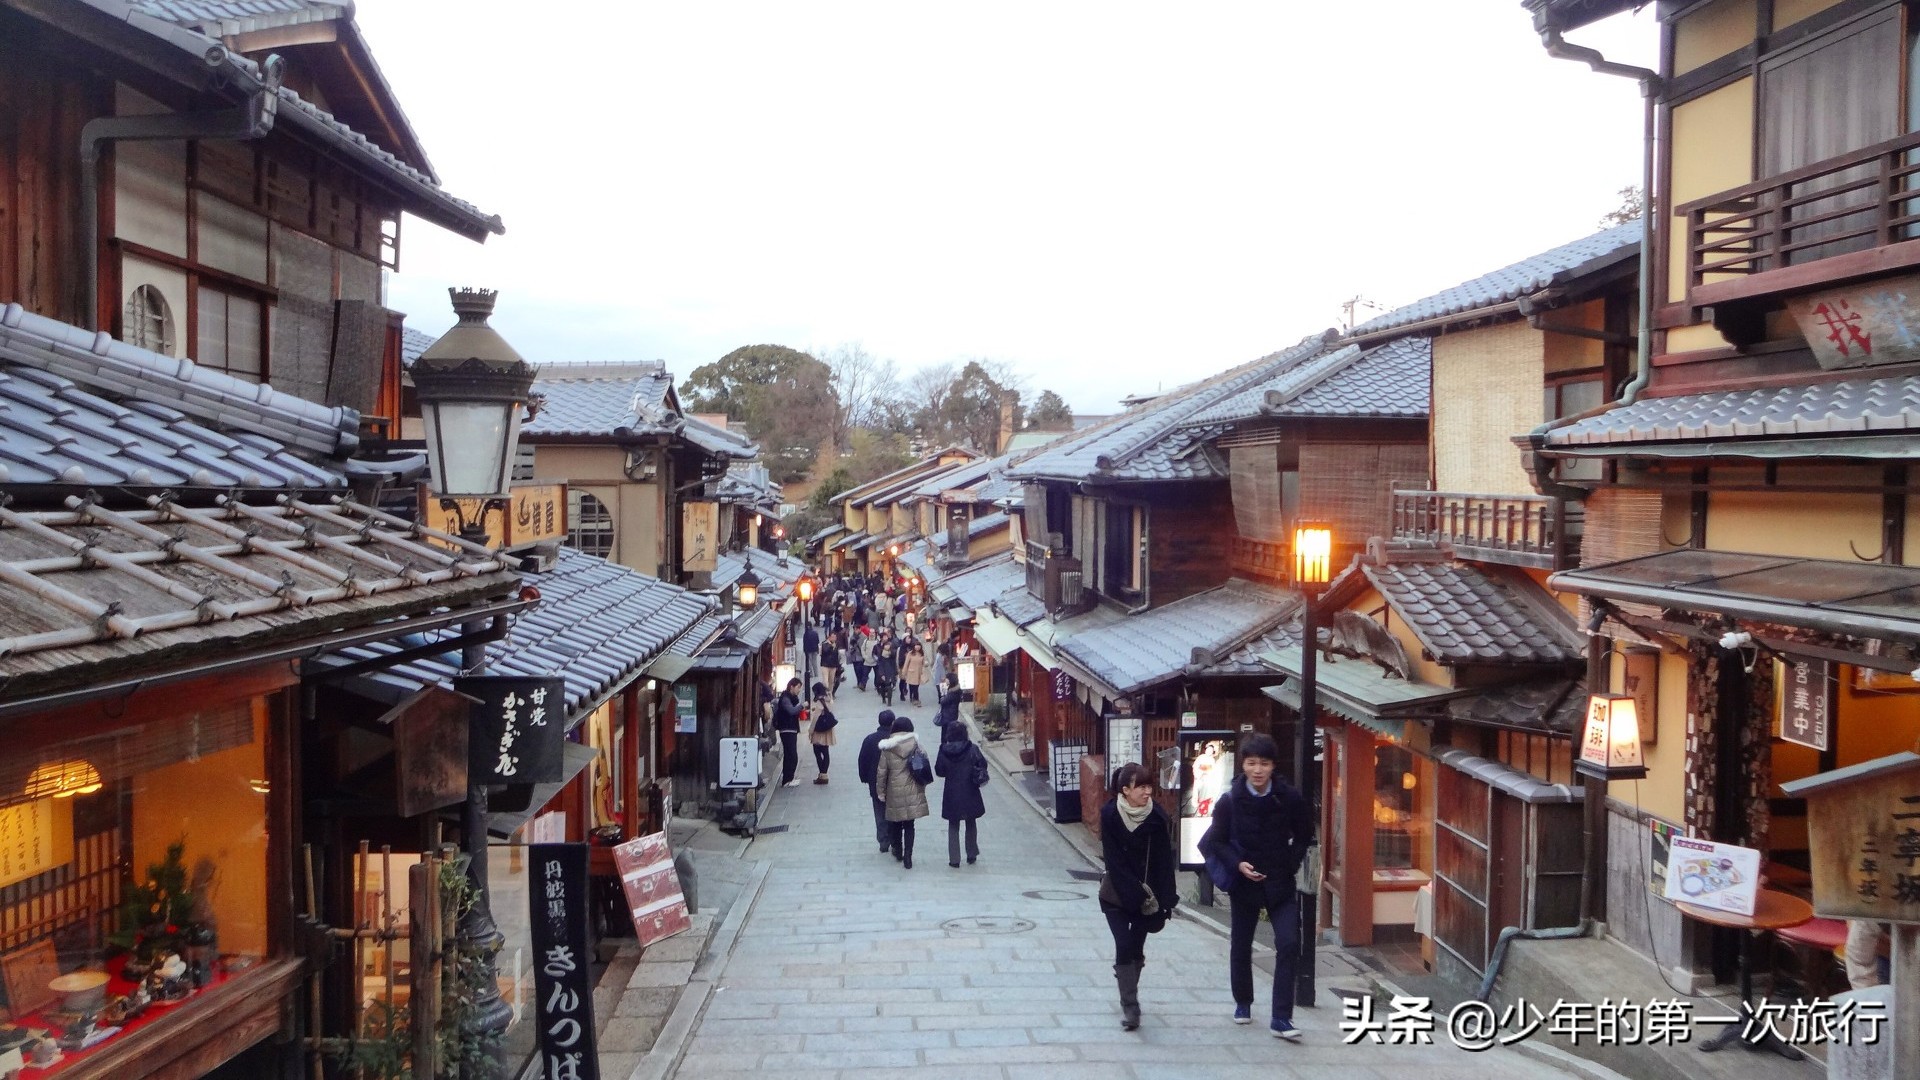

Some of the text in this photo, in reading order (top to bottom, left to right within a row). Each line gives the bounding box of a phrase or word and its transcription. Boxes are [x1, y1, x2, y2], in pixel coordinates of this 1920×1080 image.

[529, 687, 548, 726] 甘党
[1590, 703, 1607, 747] 珈琲
[1814, 695, 1824, 746] OPEN
